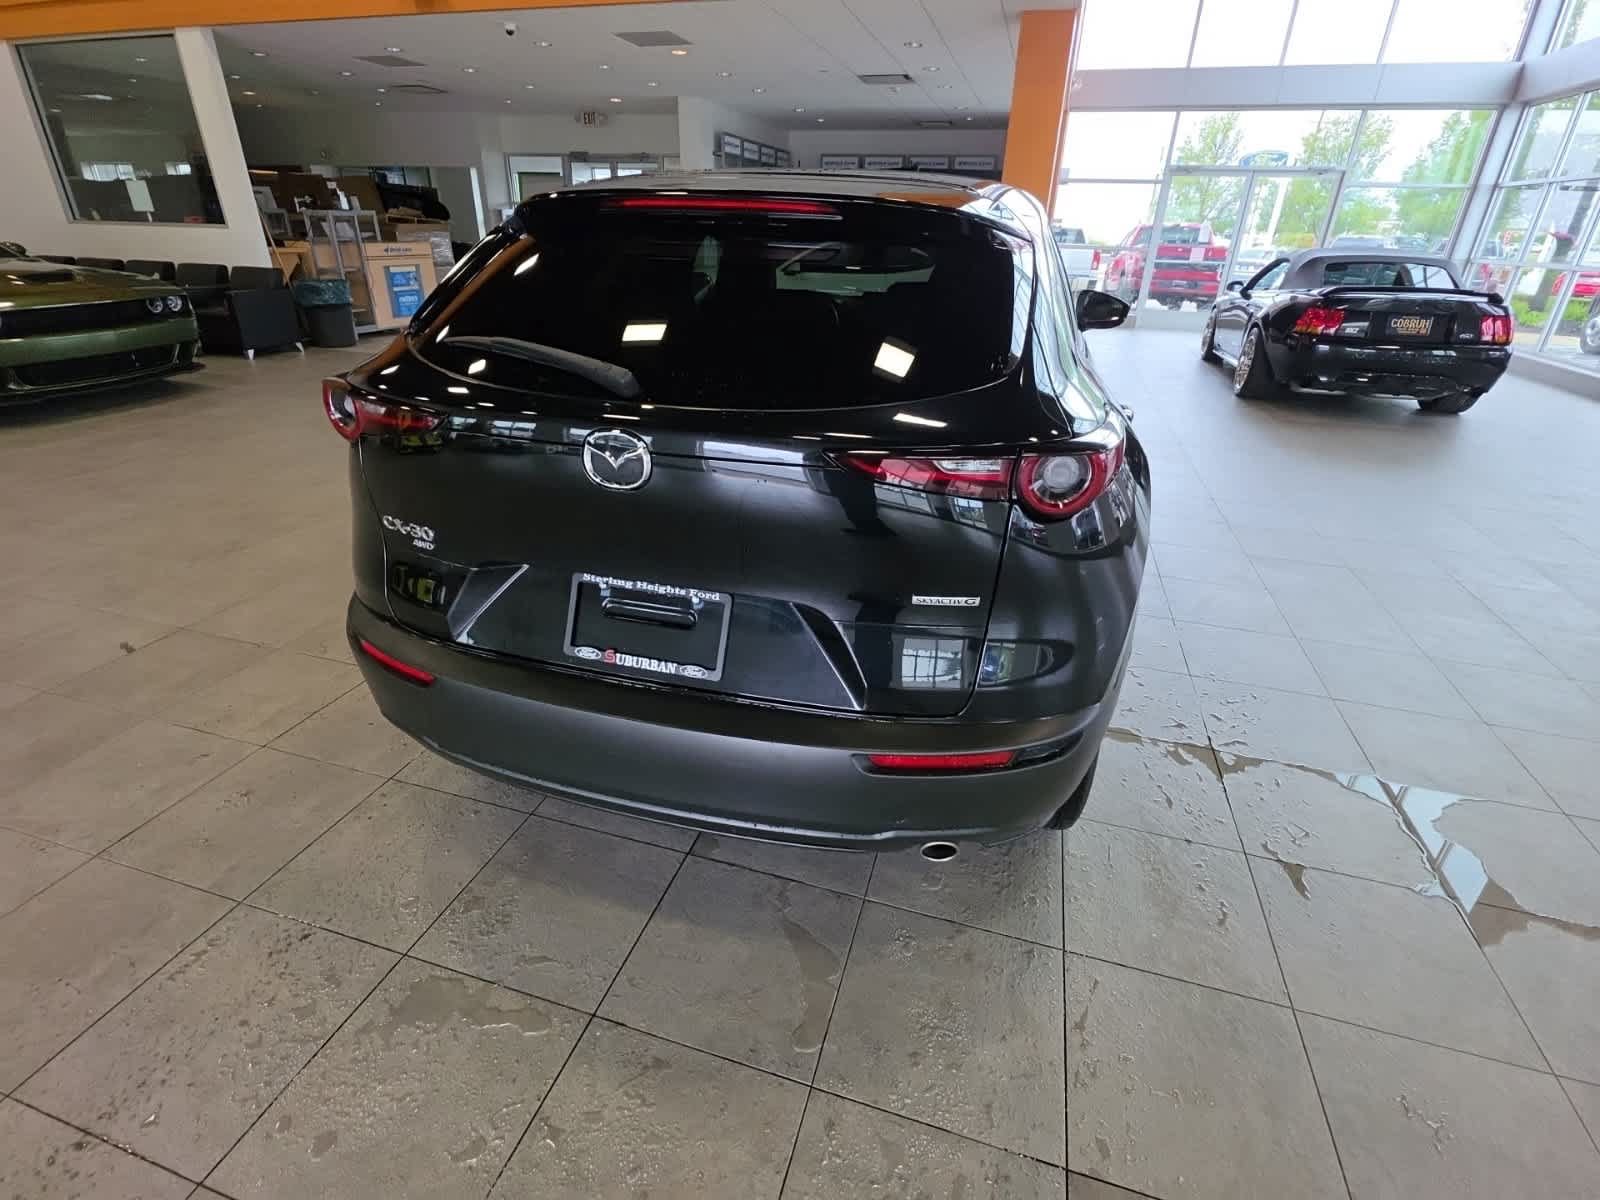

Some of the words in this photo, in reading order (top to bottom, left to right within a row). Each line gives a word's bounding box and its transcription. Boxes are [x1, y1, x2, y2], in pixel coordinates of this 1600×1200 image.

[583, 111, 597, 125] EXIT
[382, 515, 434, 541] CX-30
[412, 539, 434, 550] AWD
[582, 573, 633, 590] Sterling
[636, 580, 686, 596] Heights
[689, 588, 720, 601] Ford
[603, 649, 677, 675] SUBURBAN
